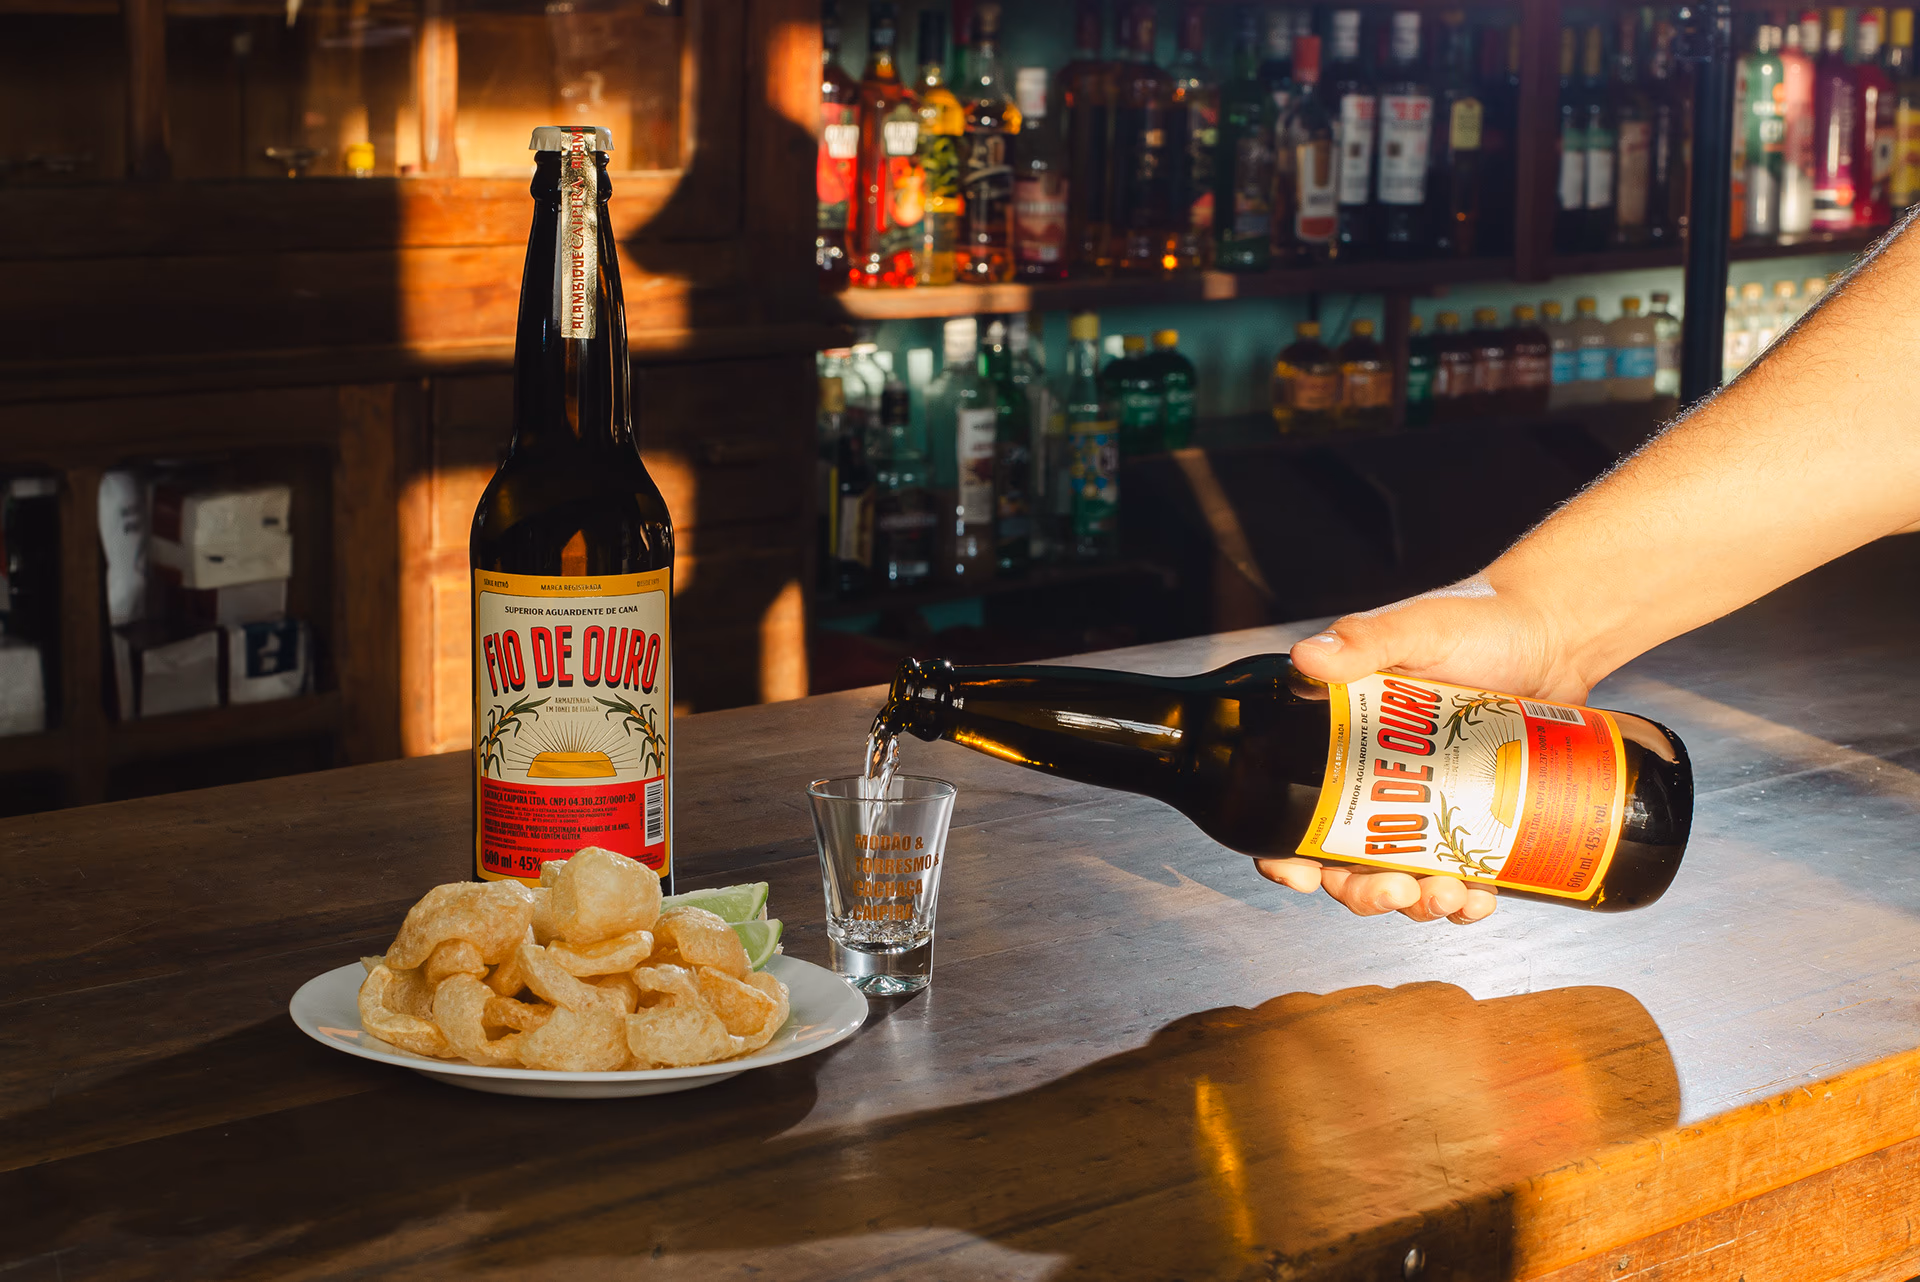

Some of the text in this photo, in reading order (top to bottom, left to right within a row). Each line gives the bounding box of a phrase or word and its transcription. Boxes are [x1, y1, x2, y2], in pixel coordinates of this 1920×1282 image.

[571, 176, 585, 330] ALAMBIQUE CAIPIRA
[564, 584, 602, 592] REGISTRADA
[504, 605, 638, 617] SUPERIOR AGUARDENTE DE CANA
[483, 625, 661, 697] FIO DE OURO
[1344, 693, 1368, 825] SUPERIOR AGUARDENTE DE CANA
[1365, 678, 1442, 855] FIO DE OURO
[1601, 749, 1612, 792] CAIPIRA
[504, 793, 528, 805] CAIPIRA
[529, 796, 548, 806] LTDA.
[549, 797, 567, 807] CNPJ
[568, 793, 636, 806] 04.310.237/0001-20
[1534, 792, 1546, 810] CNPJ
[1530, 812, 1542, 831] LTDA.
[1594, 803, 1608, 824] vol.
[1310, 816, 1327, 845] SÉRIE RETRÔ
[1585, 827, 1604, 851] 45%
[855, 832, 924, 851] MODÃO &
[1520, 831, 1538, 856] CAIPIRA
[485, 849, 541, 872] 600 ml 45%
[854, 853, 940, 874] TORRESMO &
[1509, 856, 1530, 879] CACHAÇA
[1580, 857, 1593, 870] ml
[853, 879, 923, 899] CACHAÇA
[1567, 871, 1587, 888] 600
